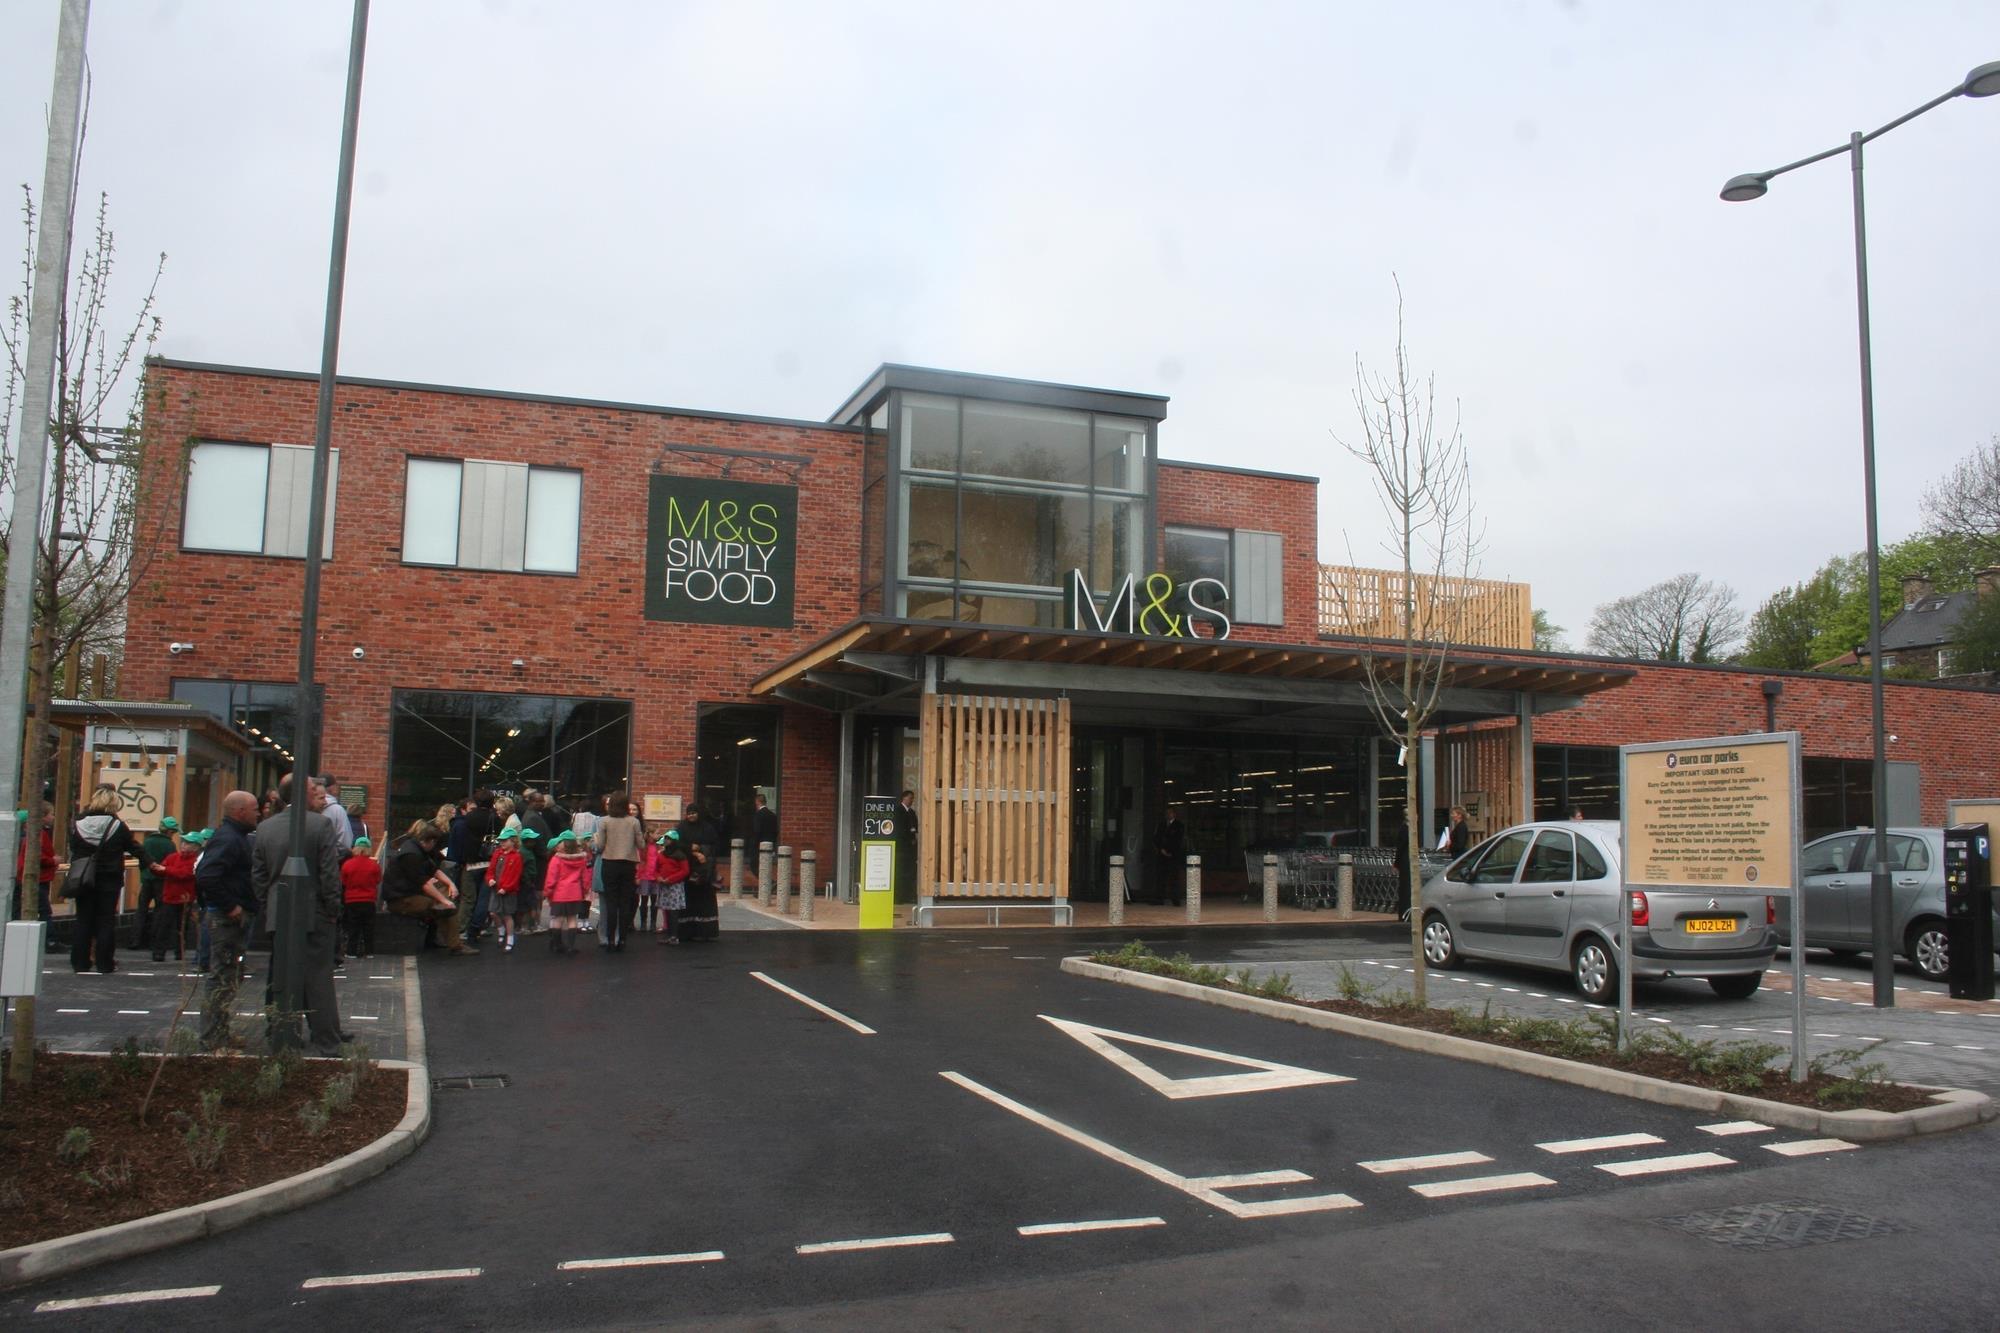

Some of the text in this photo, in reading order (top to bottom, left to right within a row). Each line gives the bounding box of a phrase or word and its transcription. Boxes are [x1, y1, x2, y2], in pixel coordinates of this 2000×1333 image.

[668, 497, 777, 544] M&S
[667, 538, 776, 572] SIMPLY
[666, 568, 776, 605] FOOD
[1074, 568, 1230, 640] M&S
[1680, 755, 1698, 765] euro
[1701, 754, 1712, 763] car
[1715, 751, 1738, 764] parks
[865, 819, 893, 835] £10
[1979, 838, 1987, 854] P
[1689, 920, 1732, 930] NJ02 LZH
